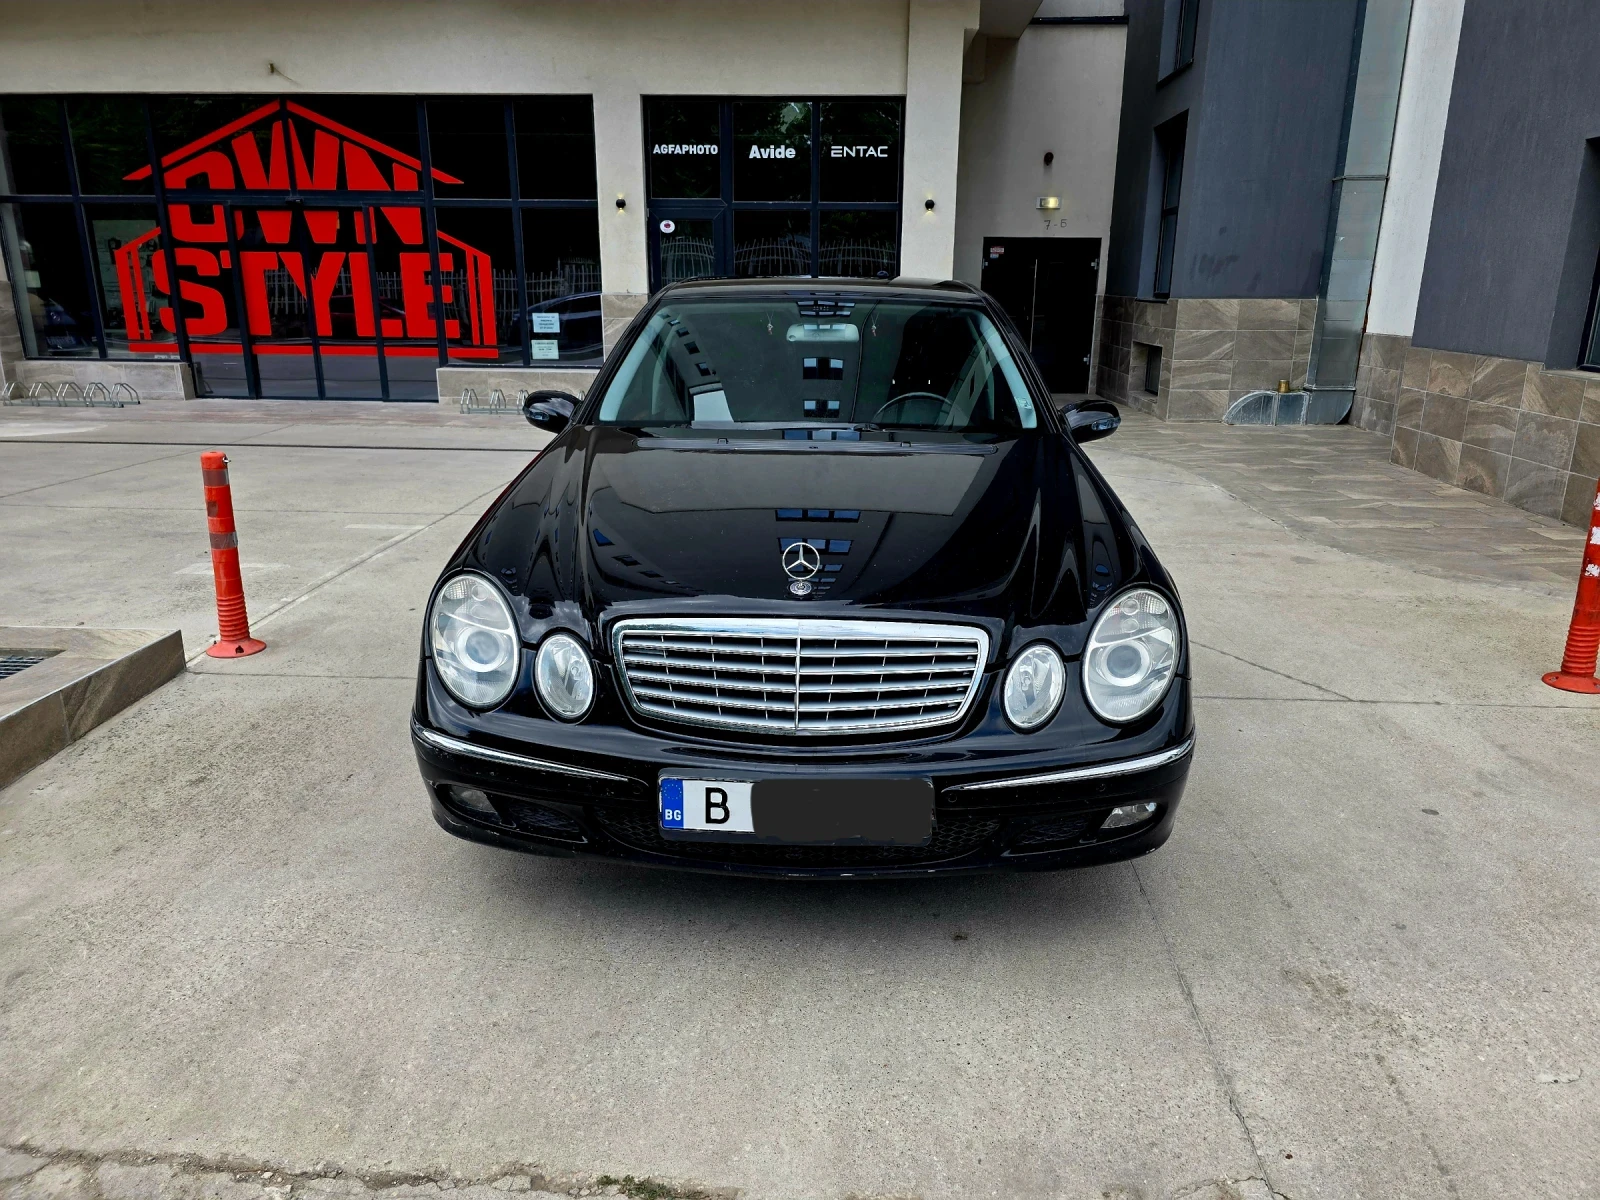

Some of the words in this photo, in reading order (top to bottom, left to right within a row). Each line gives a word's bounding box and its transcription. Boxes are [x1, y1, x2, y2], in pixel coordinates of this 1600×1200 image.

[653, 144, 719, 155] AGFAPHOTO
[749, 144, 796, 159] Avide
[830, 145, 888, 158] ENTAC
[164, 118, 423, 244] OWN
[152, 248, 461, 339] STYLE
[705, 786, 731, 825] B
[664, 808, 682, 821] BG
